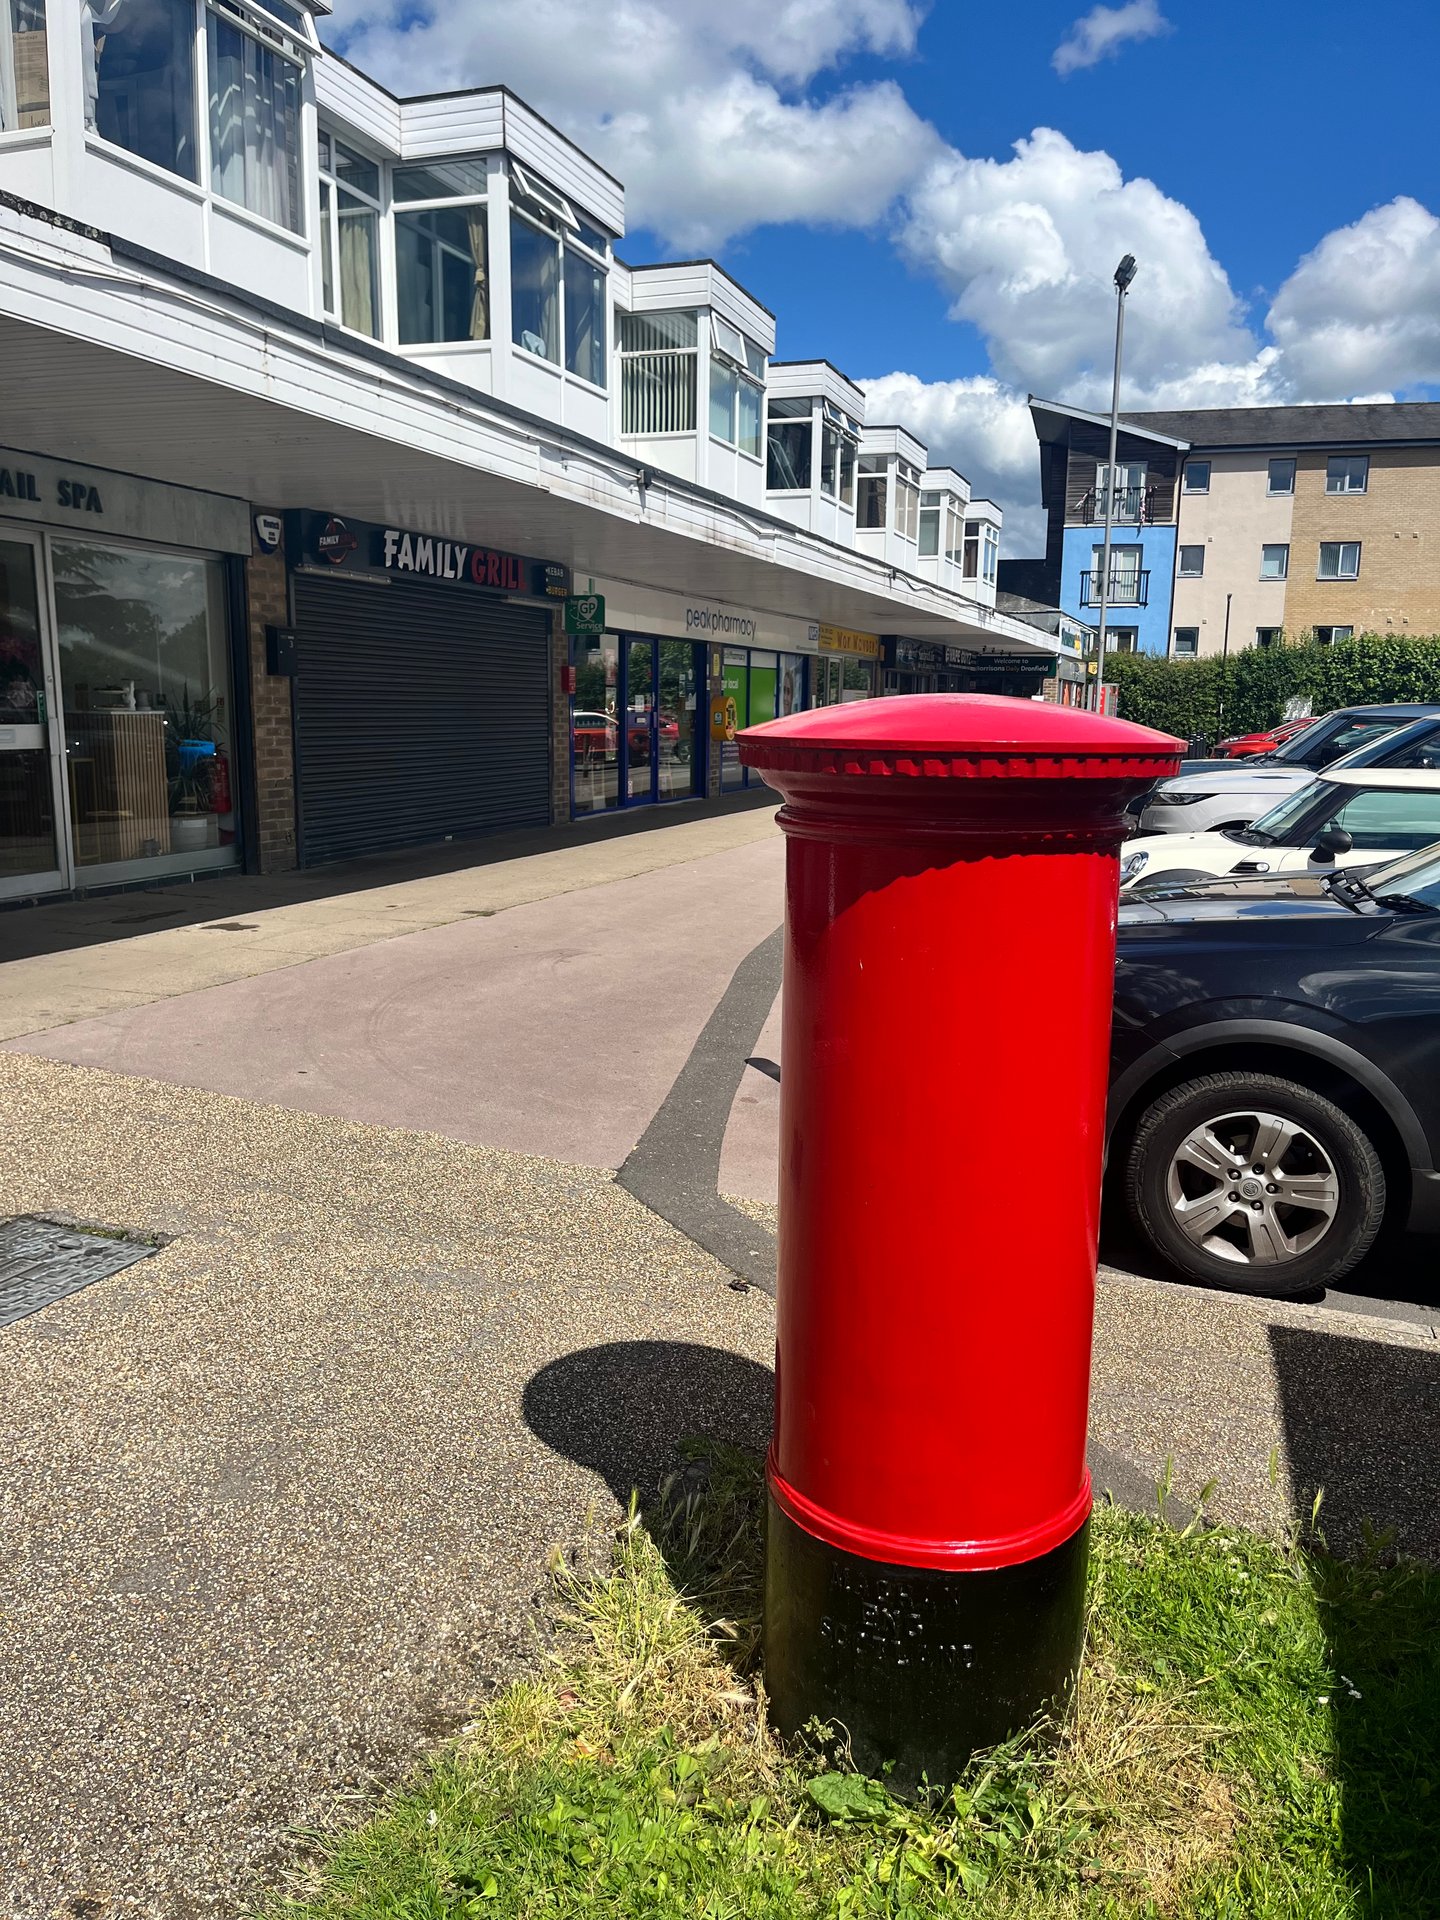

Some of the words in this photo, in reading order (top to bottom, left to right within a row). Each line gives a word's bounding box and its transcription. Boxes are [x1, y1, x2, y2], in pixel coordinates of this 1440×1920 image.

[57, 479, 104, 513] SPA
[319, 535, 341, 547] FAMILY
[384, 530, 468, 580] FAMILY
[471, 549, 527, 592] GRILL
[547, 566, 564, 578] KEBAB
[579, 602, 596, 614] GP
[576, 621, 604, 630] Service
[289, 640, 294, 648] 3
[1005, 665, 1020, 673] Daily
